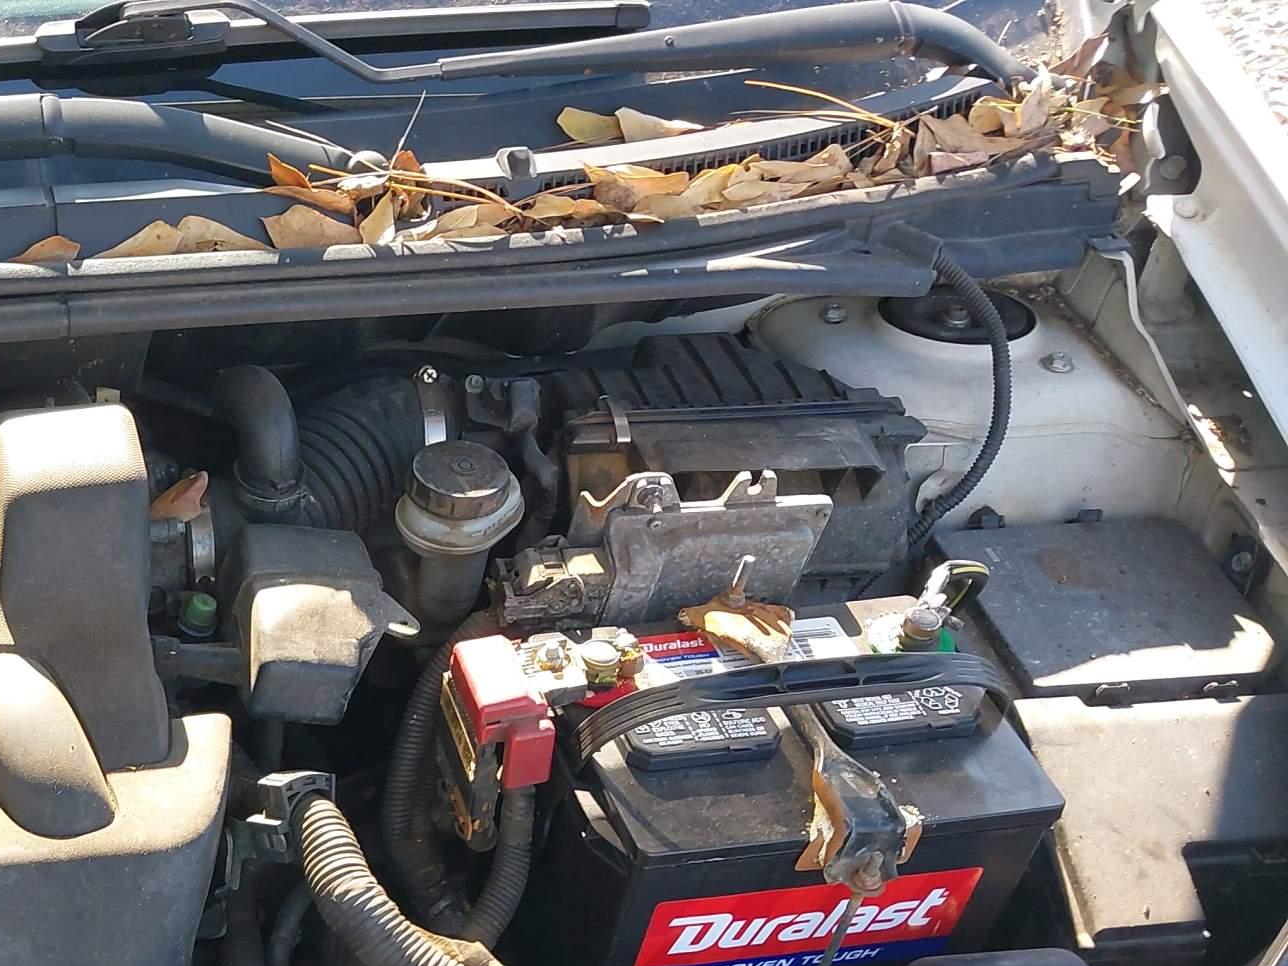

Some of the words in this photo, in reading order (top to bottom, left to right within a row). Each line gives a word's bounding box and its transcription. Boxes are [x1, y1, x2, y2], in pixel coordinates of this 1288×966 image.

[639, 637, 705, 653] Duralast
[667, 887, 948, 956] Duralast
[802, 947, 880, 966] TOUGH
